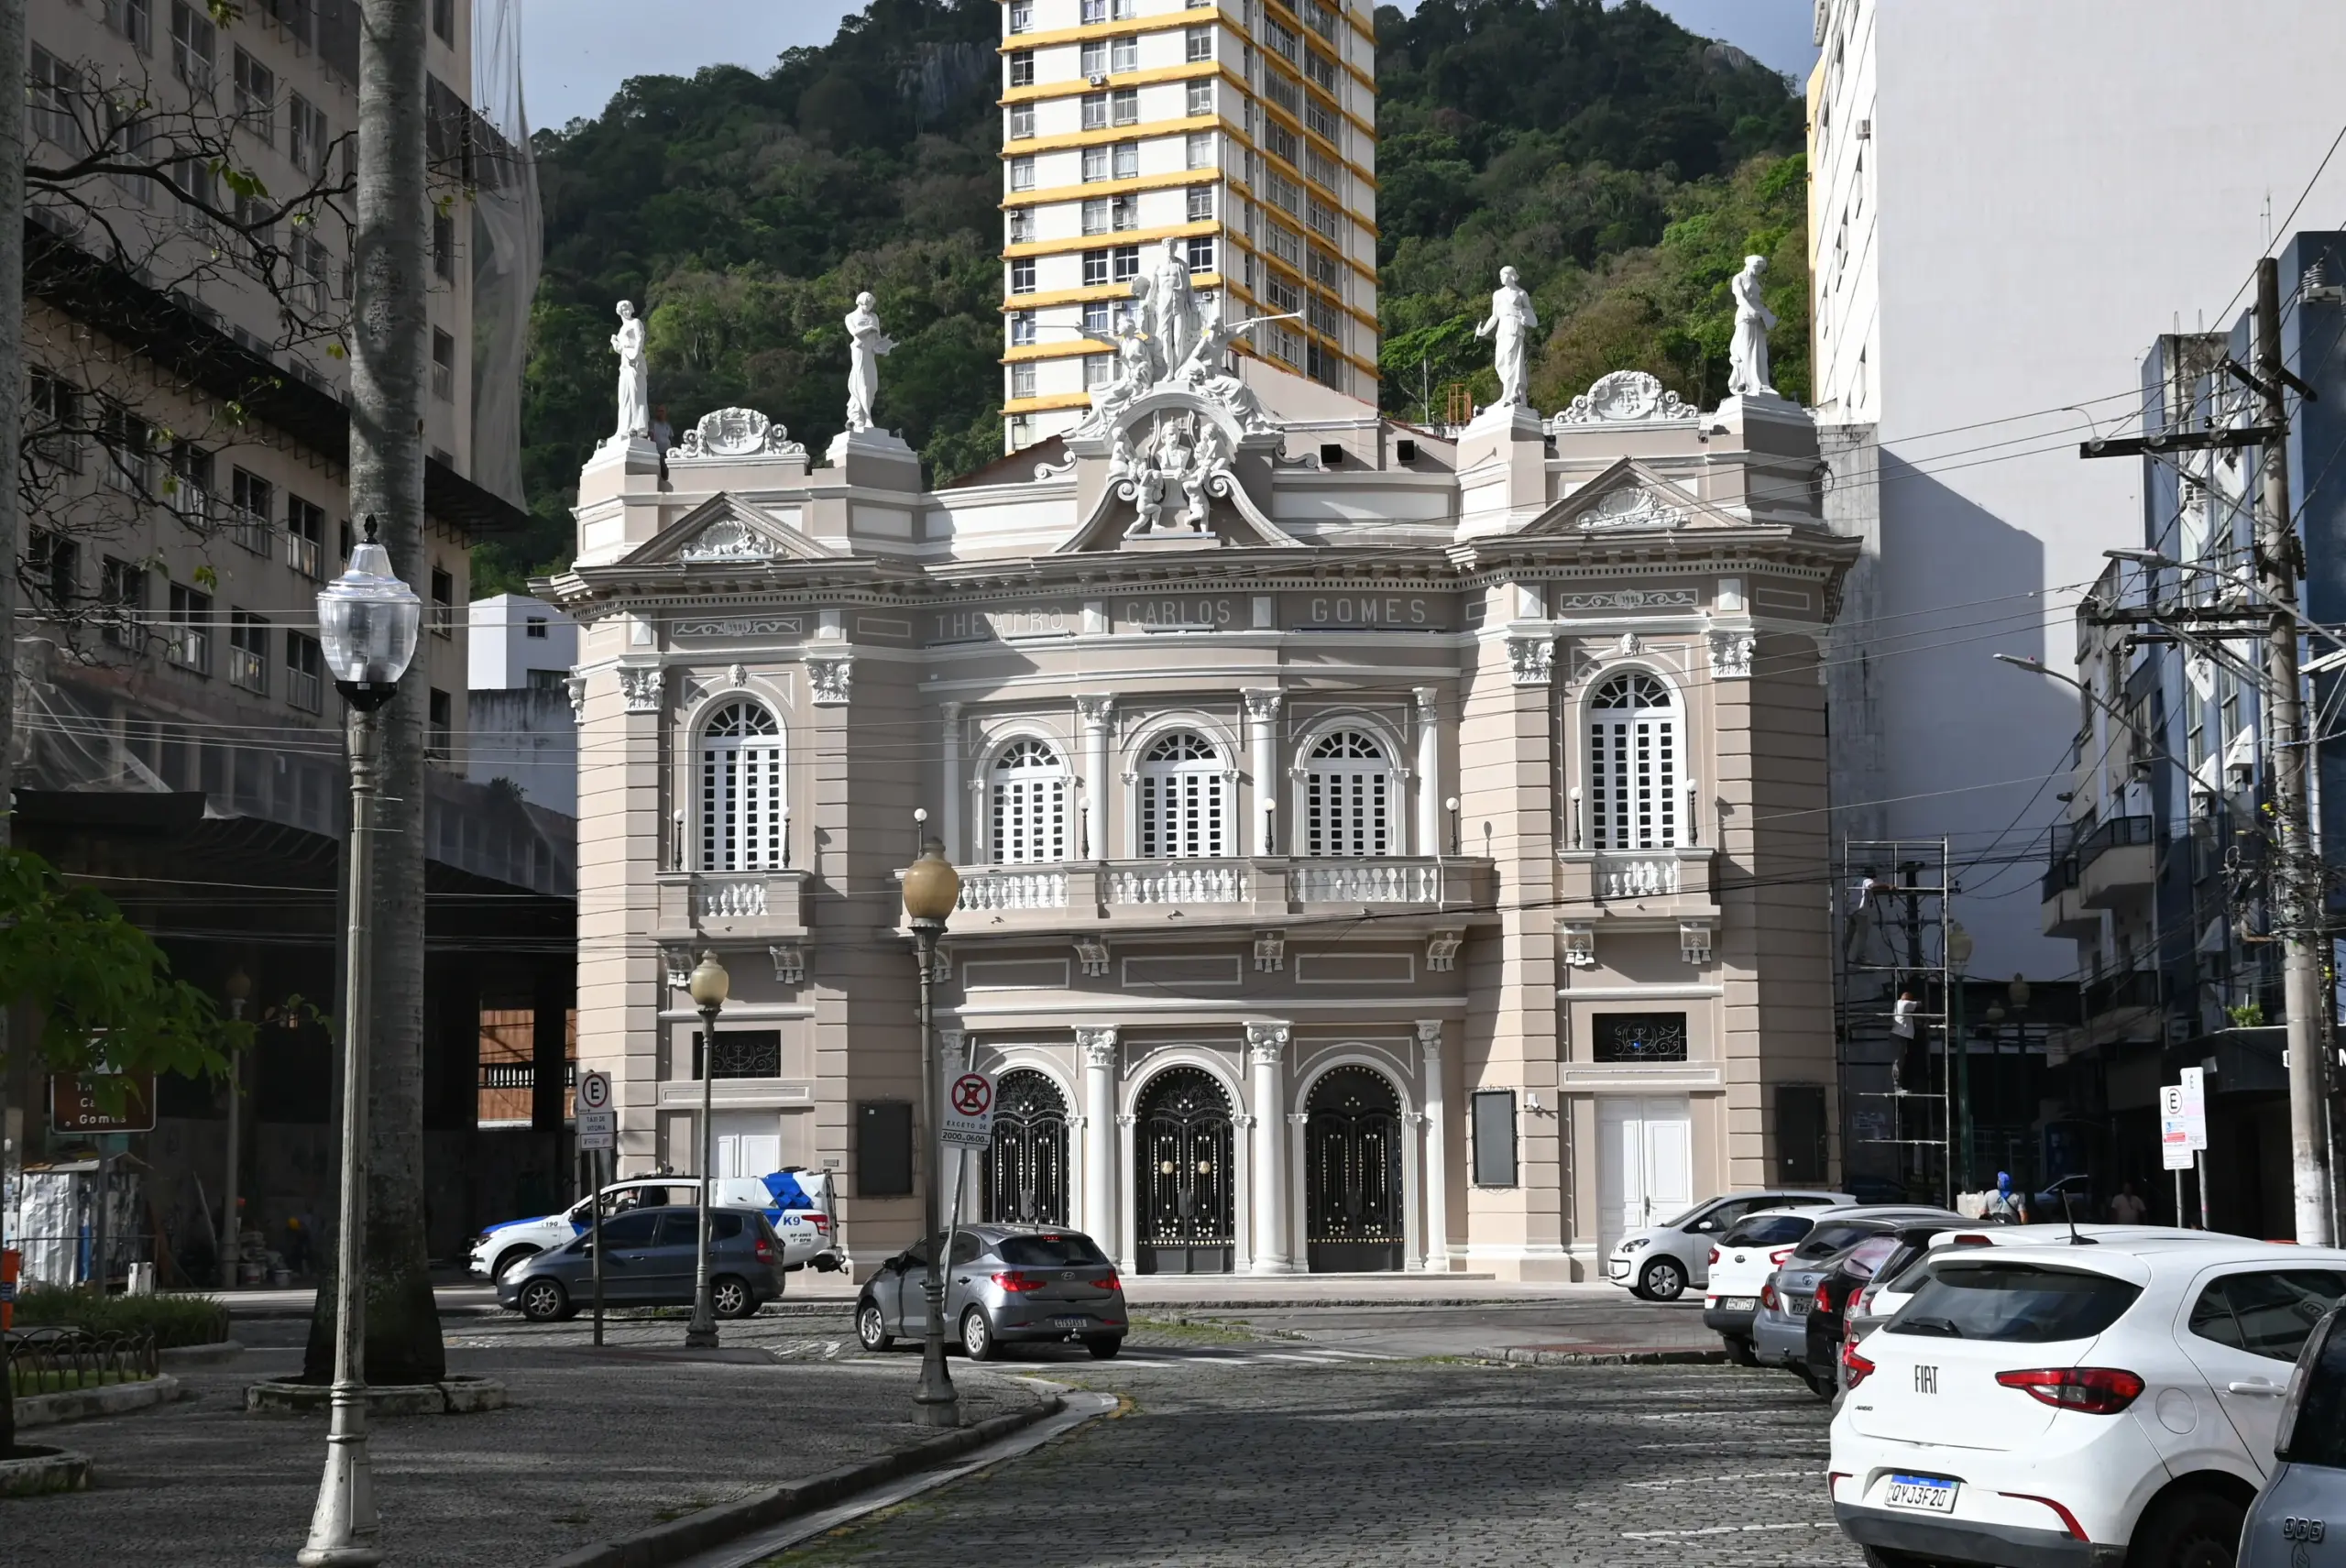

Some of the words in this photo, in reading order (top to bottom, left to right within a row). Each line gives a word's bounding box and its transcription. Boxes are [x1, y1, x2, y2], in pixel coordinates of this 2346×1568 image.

[936, 607, 1063, 638] THEATRO
[1126, 599, 1230, 627] CARLOS
[1311, 598, 1425, 623] GOMES
[590, 1081, 599, 1099] E
[2170, 1092, 2177, 1109] E
[947, 1120, 975, 1129] EXCETO
[784, 1216, 800, 1225] K9
[1914, 1365, 1938, 1394] FIAT
[1891, 1485, 1946, 1507] QYJ3F20
